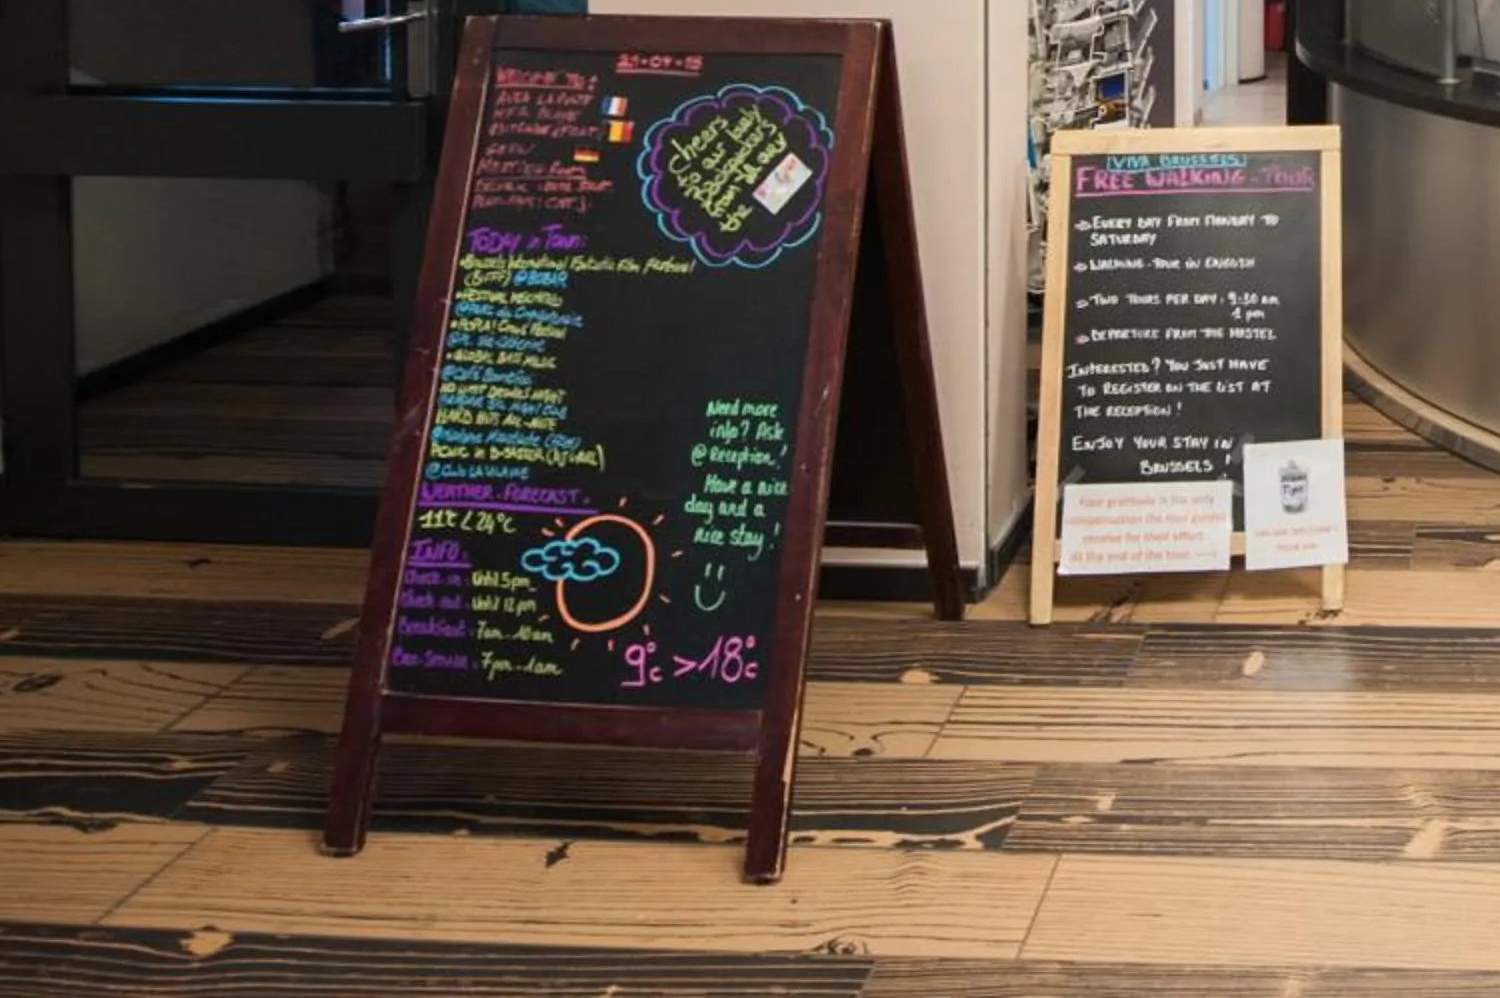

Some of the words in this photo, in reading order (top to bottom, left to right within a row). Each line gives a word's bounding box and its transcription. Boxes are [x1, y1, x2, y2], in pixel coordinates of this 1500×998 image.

[1076, 165, 1135, 191] FREE
[1145, 167, 1246, 189] WALKING
[1089, 232, 1157, 248] SATURDAY
[1164, 358, 1189, 372] YOU
[1192, 357, 1225, 372] JUST
[1228, 357, 1271, 372] HAVE
[1077, 383, 1097, 398] TO
[1102, 381, 1162, 396] REGISTER
[706, 397, 739, 418] Need
[741, 403, 778, 418] more
[1073, 403, 1102, 420] THE
[1071, 434, 1125, 452] ENJOY
[1133, 435, 1168, 450] YOUR
[1172, 434, 1210, 450] STAY
[1213, 435, 1234, 450] IN
[684, 493, 714, 525] day
[717, 497, 747, 518] and
[753, 503, 767, 518] a
